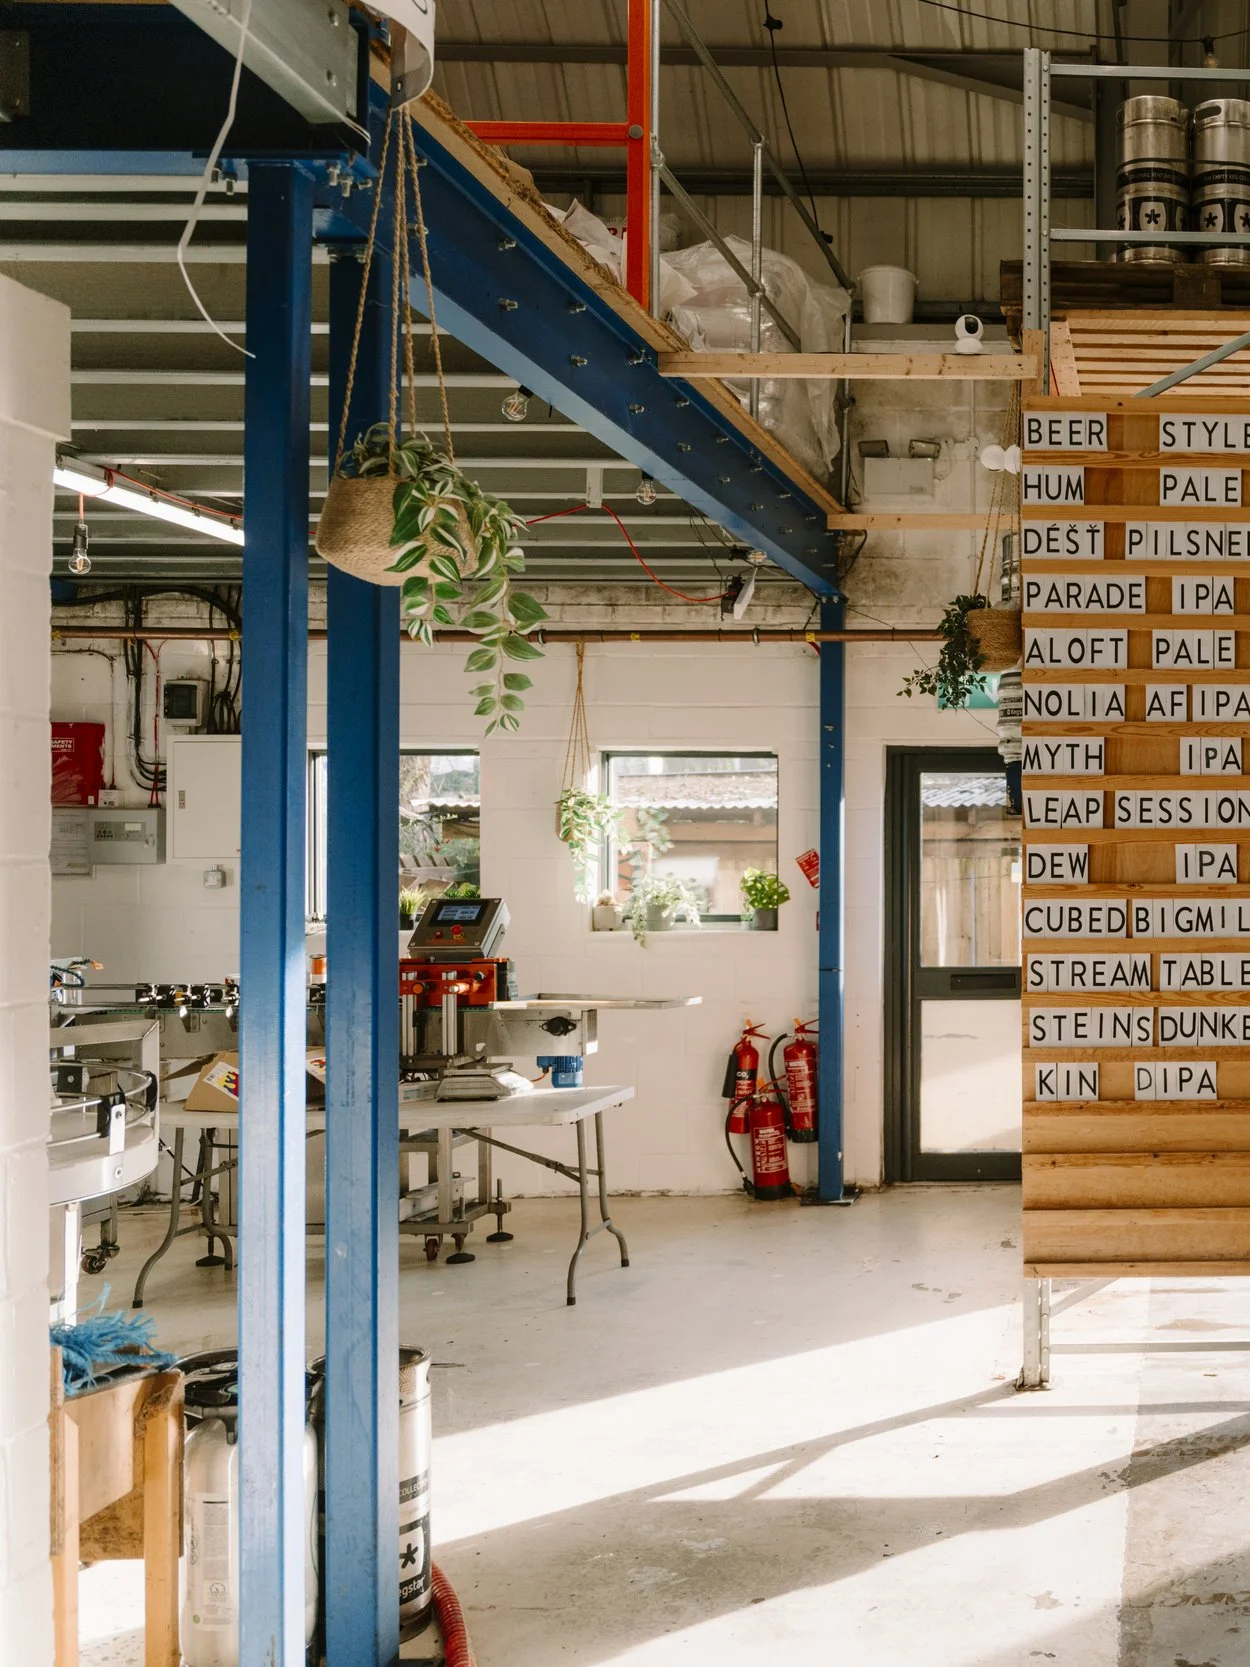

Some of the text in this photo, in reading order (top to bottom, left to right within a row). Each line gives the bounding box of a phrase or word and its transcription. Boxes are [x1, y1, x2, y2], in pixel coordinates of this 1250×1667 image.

[1027, 417, 1105, 446] BEER
[1023, 474, 1084, 500] HUM
[1162, 474, 1239, 502] PALE
[1026, 581, 1143, 609] PARADE
[1180, 583, 1234, 610] IPA
[1026, 637, 1124, 664] ALOFT
[1155, 636, 1233, 664] PALE
[1024, 689, 1124, 717] NOLIA
[1147, 690, 1184, 716] AF
[1022, 743, 1103, 770] MYTH
[1187, 743, 1241, 770] IPA
[1027, 796, 1100, 824] LEAP
[1027, 852, 1088, 878] DEW
[1183, 850, 1237, 878] IPA
[1025, 906, 1126, 933] CUBED
[1029, 960, 1150, 987] STREAM
[1032, 1012, 1151, 1042] STEINS
[1039, 1069, 1097, 1096] KIN
[1137, 1067, 1216, 1094] DIPA
